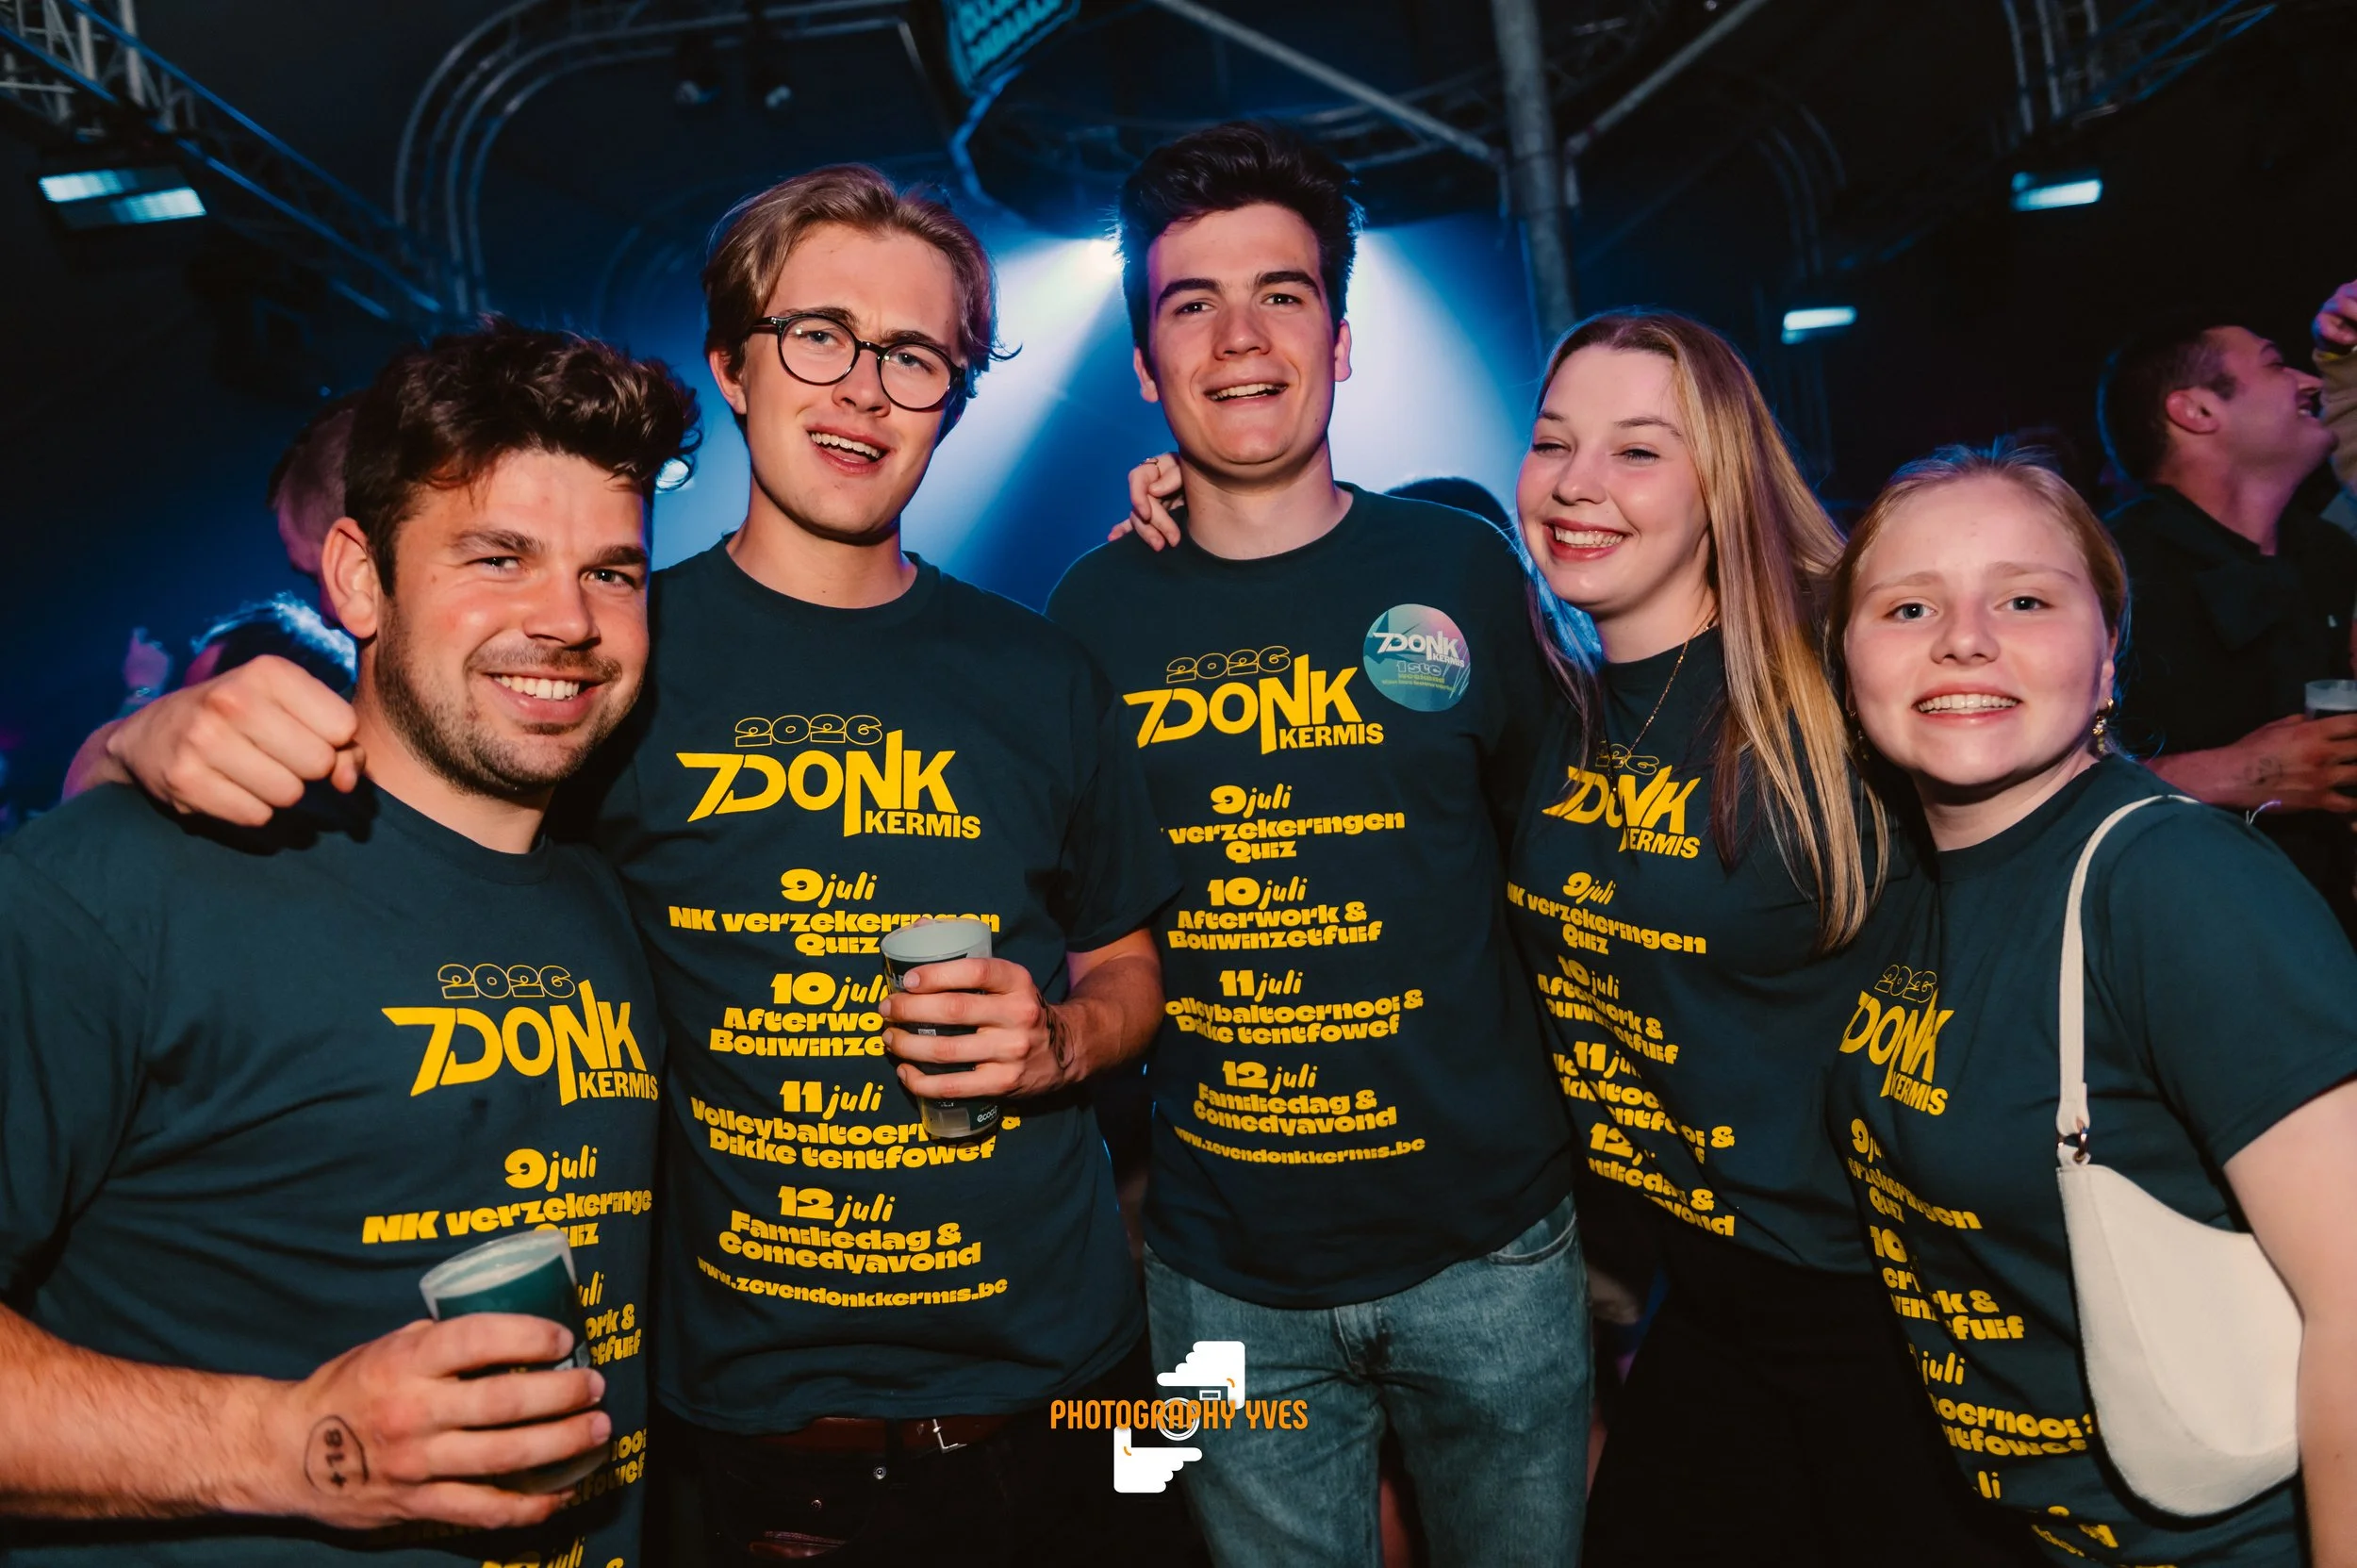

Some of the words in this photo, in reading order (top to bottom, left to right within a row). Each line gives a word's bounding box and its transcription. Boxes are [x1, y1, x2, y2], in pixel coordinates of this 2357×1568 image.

[1373, 631, 1459, 661] 7DONK
[1166, 646, 1291, 684] 2026
[1123, 653, 1362, 754] 7DONK
[734, 714, 882, 748] 2026
[1279, 722, 1384, 750] KERMIS
[676, 729, 958, 837] 7DONK
[1211, 784, 1246, 815] 9
[1244, 783, 1293, 818] juli
[865, 811, 981, 839] KERMIS
[1168, 812, 1405, 844] verzekeringen
[1226, 840, 1296, 864] Quiz
[781, 868, 824, 902] 9
[818, 871, 877, 908] juli
[1207, 877, 1261, 906] 10
[1259, 876, 1308, 910] juli
[1563, 871, 1591, 897] 9
[1575, 880, 1616, 905] juli
[668, 906, 717, 932] NK
[1178, 904, 1339, 929] Afterwork
[1344, 901, 1368, 923] &
[1527, 893, 1706, 954] verzekeringen
[795, 932, 881, 957] Quiz
[1168, 920, 1382, 949] Bouwinzetfuif
[1562, 923, 1609, 955] Quiz
[437, 963, 576, 999] 2026
[770, 971, 836, 1005] 10
[832, 974, 889, 1012] jul
[1219, 970, 1255, 997] 11
[1254, 969, 1303, 1002] juli
[1558, 955, 1591, 986] 10
[1591, 970, 1620, 1000] juli
[723, 1007, 884, 1032] Afterwo
[1165, 996, 1400, 1024] olleybaltoernooi
[1404, 989, 1424, 1009] &
[381, 980, 648, 1106] 7DONK
[710, 1029, 884, 1057] Bouwinze
[1645, 1017, 1663, 1040] &
[1574, 1041, 1607, 1071] 11
[576, 1071, 658, 1101] KERMIS
[1222, 1061, 1269, 1089] 12
[1269, 1064, 1318, 1095] juli
[1889, 1071, 1949, 1115] KERMIS
[780, 1081, 822, 1113] 11
[823, 1081, 883, 1119] juli
[1198, 1082, 1349, 1114] Familiedag
[1355, 1089, 1377, 1110] &
[690, 1097, 929, 1145] Volleybaltoer
[1194, 1099, 1397, 1136] Comedyavond
[710, 1127, 796, 1164] Dikke
[1591, 1123, 1633, 1158] 12
[1710, 1126, 1735, 1148] &
[1851, 1118, 1869, 1153] 9
[503, 1147, 548, 1189] 9
[545, 1145, 598, 1193] juli
[362, 1211, 439, 1244] NK
[445, 1189, 652, 1237] verzekeringe
[778, 1185, 833, 1221] 12
[834, 1194, 896, 1230] juli
[1690, 1189, 1714, 1211] &
[731, 1210, 931, 1252] Familiedag
[936, 1222, 962, 1247] &
[1870, 1225, 1907, 1263] 10
[718, 1230, 981, 1274] Comedyavond
[621, 1303, 635, 1330] &
[1969, 1290, 2000, 1312] &
[1922, 1350, 1965, 1385] juli
